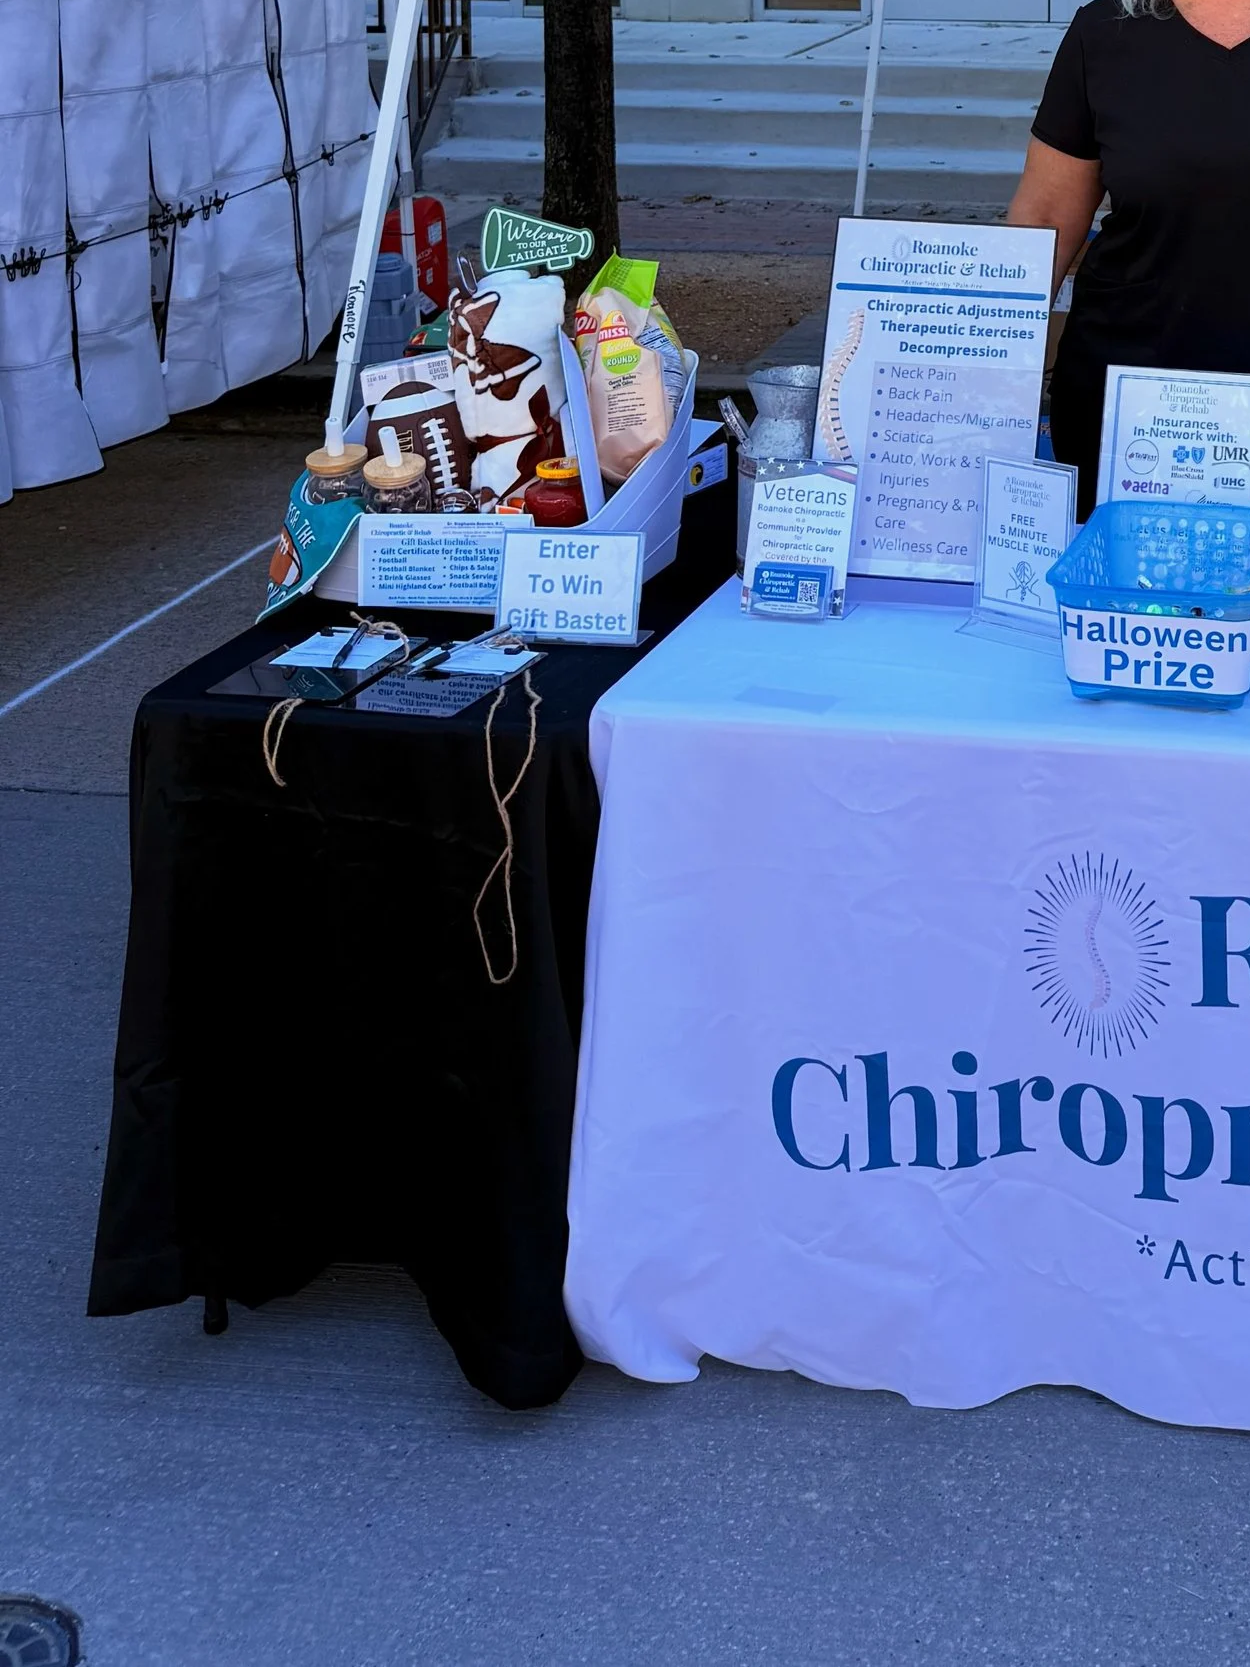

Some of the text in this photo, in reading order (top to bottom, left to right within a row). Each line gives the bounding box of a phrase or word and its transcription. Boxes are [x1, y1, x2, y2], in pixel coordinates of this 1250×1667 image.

[503, 218, 577, 242] Welcome
[529, 240, 547, 248] OUR
[912, 240, 979, 257] Roanoke
[508, 243, 568, 264] TAILGATE
[860, 256, 1027, 280] Chiropractic & Rehab
[867, 299, 1048, 320] Chiropractic Adjustments
[880, 320, 1035, 340] Therapeutic Exercises
[899, 341, 1008, 359] Decompression
[890, 366, 957, 381] Neck Pain
[888, 387, 953, 402] Back Pain
[1169, 384, 1210, 396] Roanoke
[1159, 392, 1218, 406] Chiropractic
[1180, 404, 1210, 415] Rehab
[886, 409, 1033, 430] Headaches/Migraines
[1153, 415, 1219, 431] Insurances
[883, 430, 934, 444] Sciatica
[1133, 426, 1238, 444] In-Network with:
[881, 451, 916, 466] Auto,
[921, 453, 957, 468] Work
[960, 455, 971, 468] &
[1212, 445, 1250, 462] UMR
[879, 473, 930, 488] Injuries
[1011, 477, 1044, 491] Roanoke
[1132, 480, 1170, 495] aetna
[1221, 477, 1246, 488] UHC
[764, 483, 847, 506] Veterans
[1003, 485, 1051, 501] Chiropractic
[757, 503, 846, 518] Roanoke Chiropractic
[877, 493, 952, 513] Pregnancy
[952, 499, 963, 511] &
[1020, 496, 1044, 509] Rehab
[875, 516, 906, 530] Care
[1011, 513, 1035, 527] FREE
[295, 518, 317, 550] THE
[757, 522, 842, 536] Community Provider
[1008, 526, 1048, 543] MINUTE
[401, 538, 479, 546] Gift Basket Includes:
[539, 539, 600, 560] Enter
[762, 540, 834, 553] Chiropractic Care
[872, 537, 968, 556] Wellness Care
[988, 535, 1063, 559] MUSCLE WORK
[765, 552, 827, 564] Covered the
[449, 564, 468, 572] Chips
[396, 583, 427, 591] Highland
[480, 582, 496, 590] Baby
[528, 574, 603, 595] To Win
[507, 608, 627, 632] Gift Bastet
[1061, 610, 1249, 654] Halloween
[1103, 648, 1215, 691] Prize
